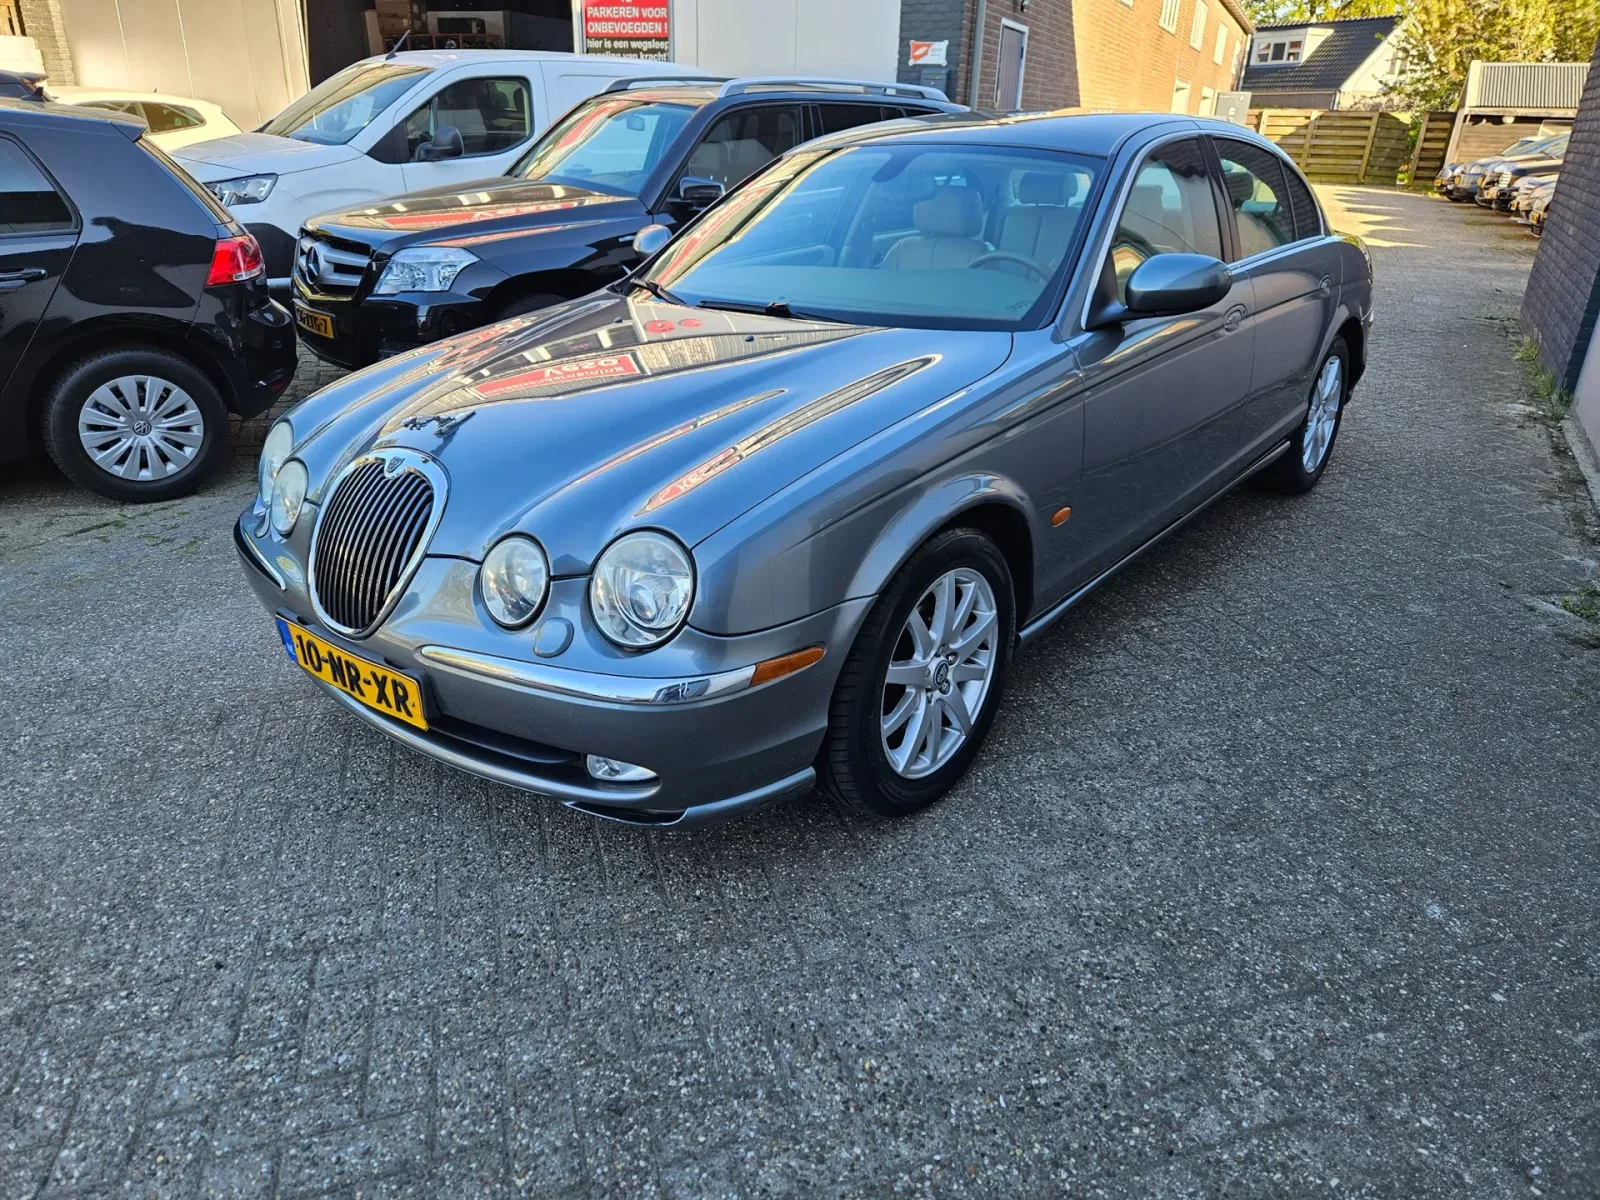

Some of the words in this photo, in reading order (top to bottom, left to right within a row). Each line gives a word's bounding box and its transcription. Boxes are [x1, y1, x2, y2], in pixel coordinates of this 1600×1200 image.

[587, 6, 639, 18] PARKEREN
[641, 7, 668, 18] VOOR
[587, 21, 662, 34] ONBEVOEGDEN
[586, 38, 602, 48] hier
[604, 38, 612, 48] is
[613, 40, 629, 49] een
[630, 39, 669, 51] wegsleep
[296, 634, 413, 718] 10-NR-XR
